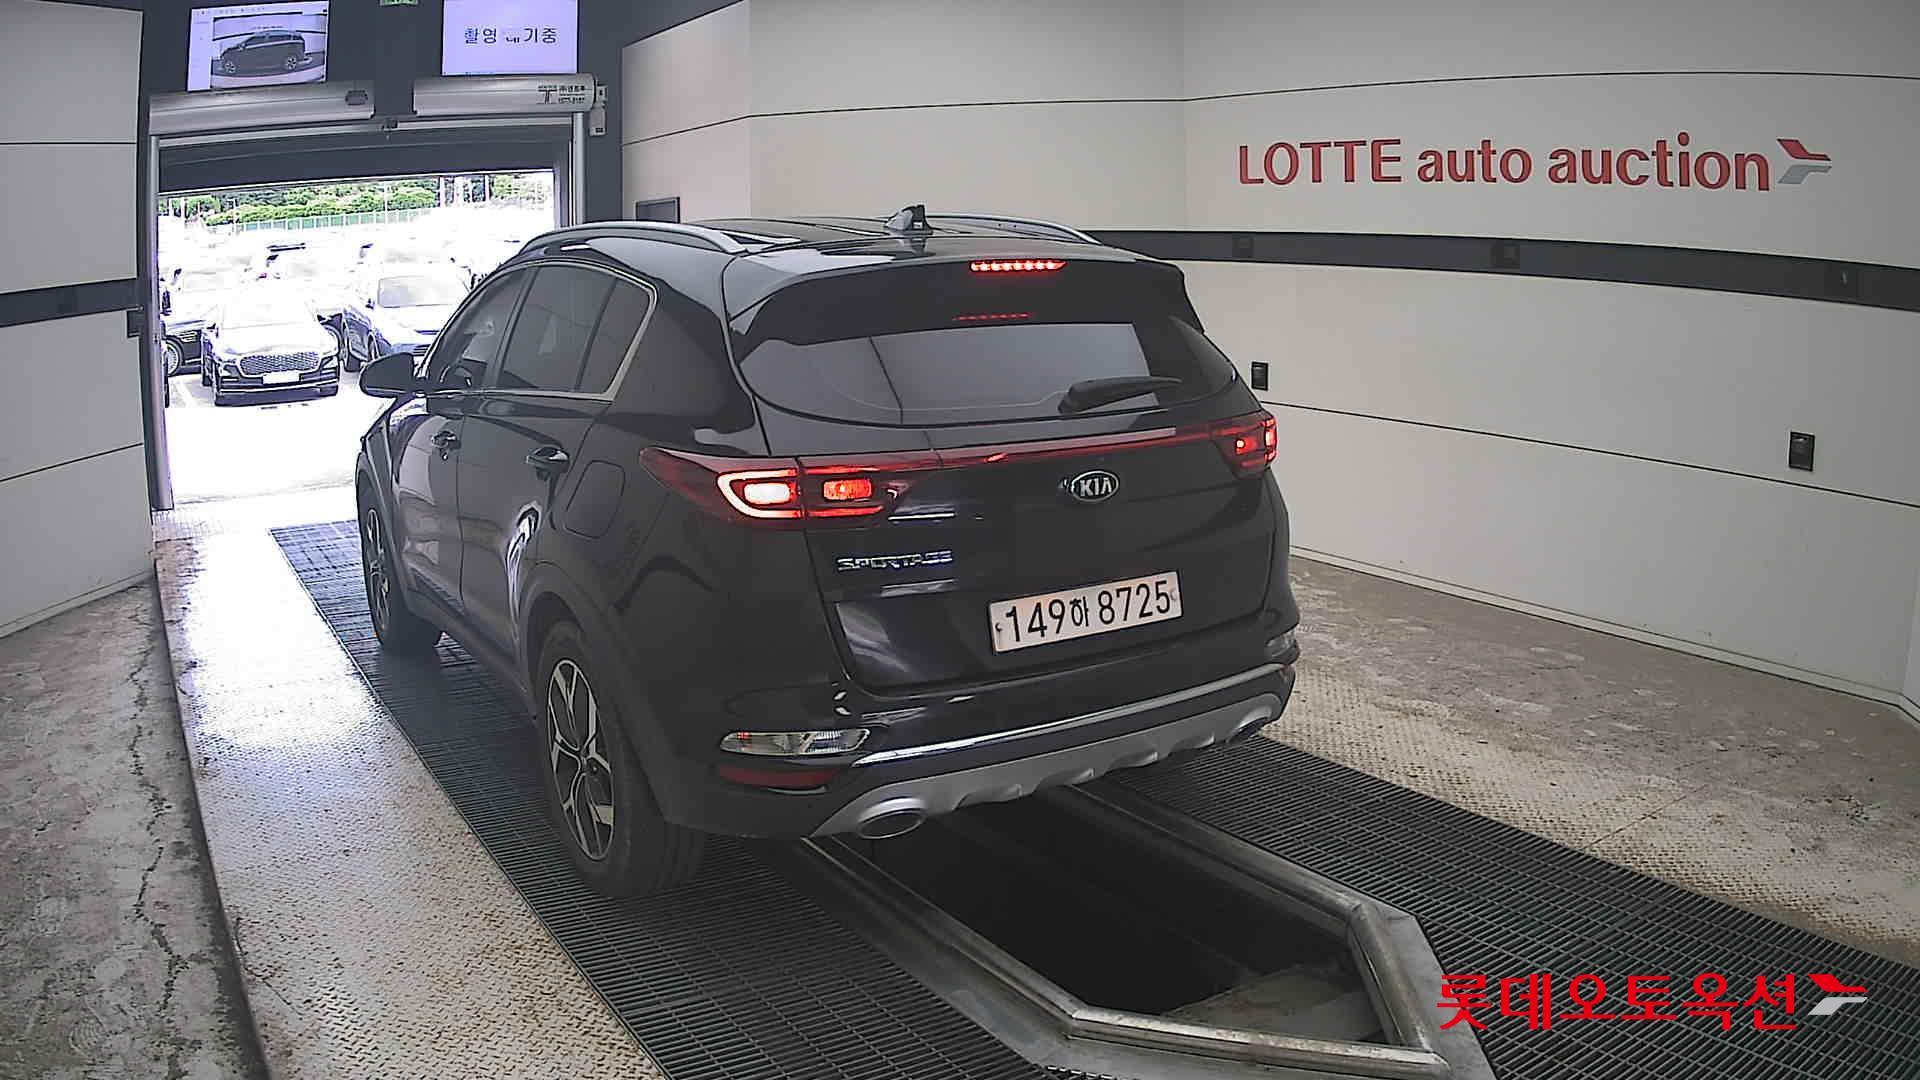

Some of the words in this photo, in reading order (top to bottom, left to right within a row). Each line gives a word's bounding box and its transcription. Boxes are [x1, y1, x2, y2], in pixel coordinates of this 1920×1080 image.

[1239, 138, 1401, 184] LOTTE
[1417, 139, 1533, 184] auto
[1548, 131, 1771, 191] auction
[1079, 477, 1112, 497] KIA
[1006, 596, 1089, 642] 149하
[1097, 580, 1171, 625] 8725
